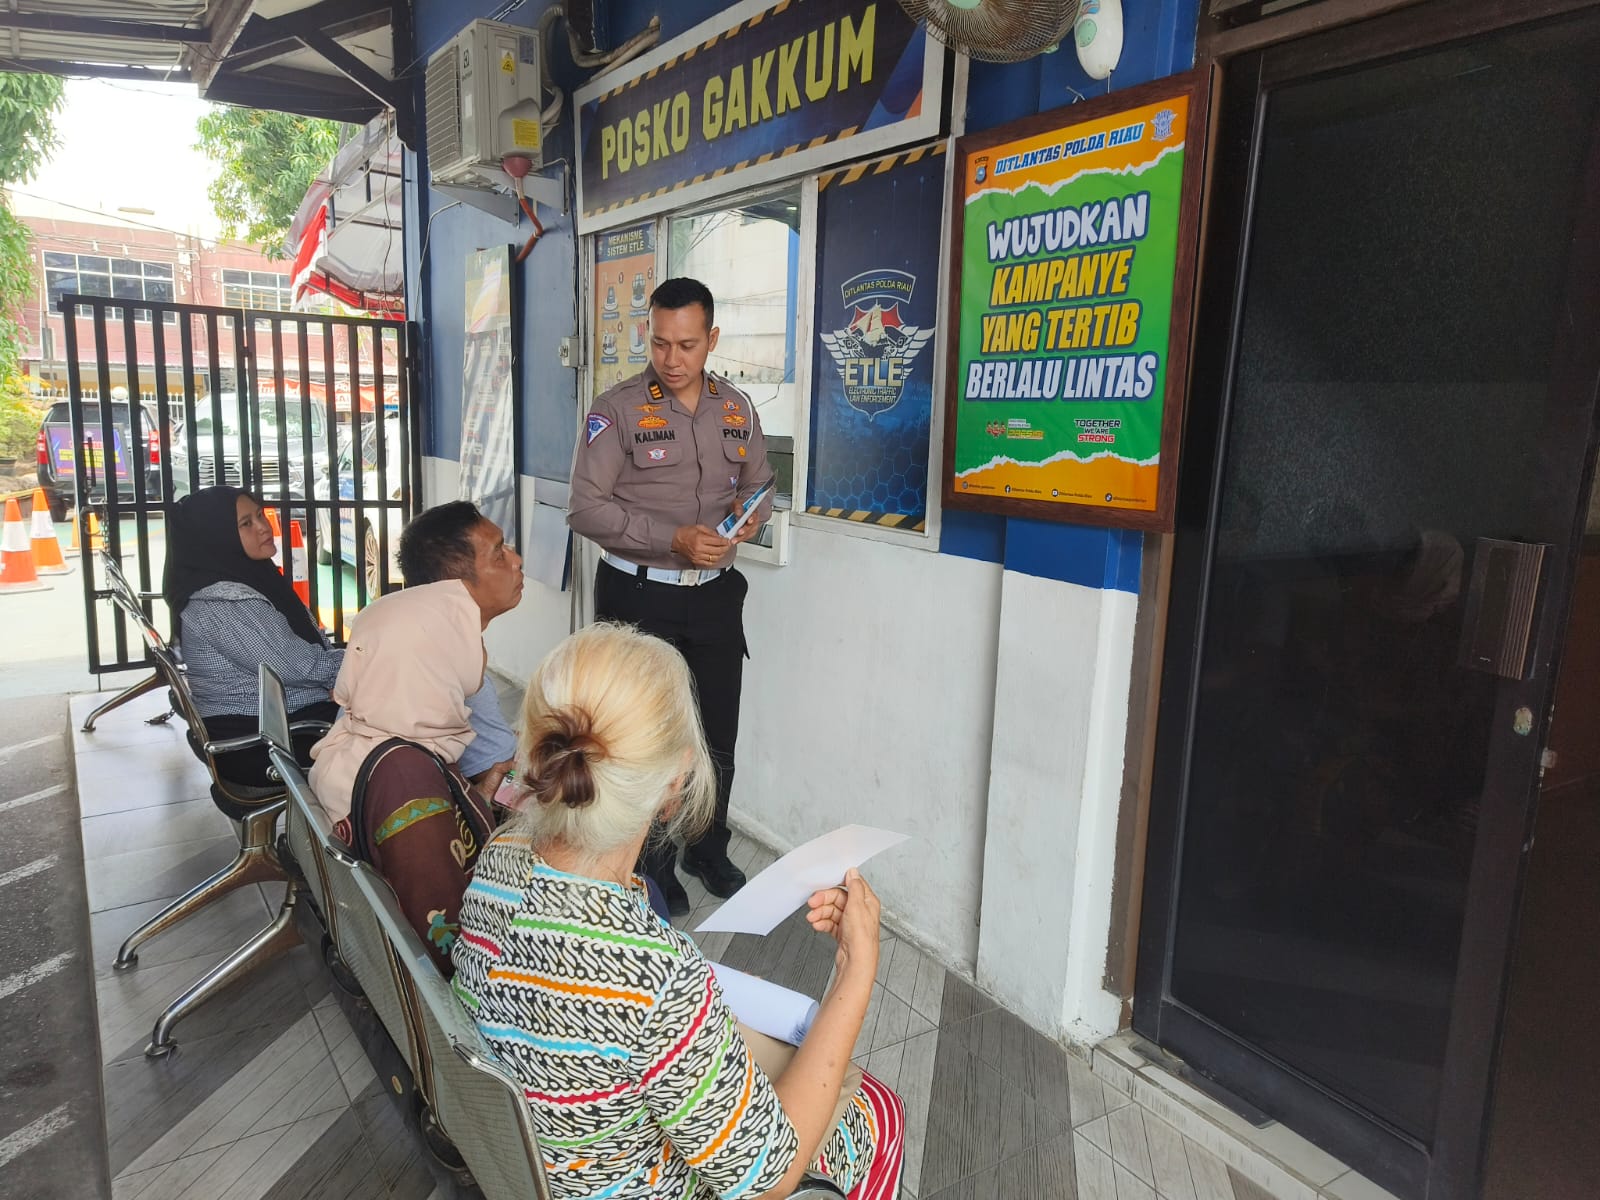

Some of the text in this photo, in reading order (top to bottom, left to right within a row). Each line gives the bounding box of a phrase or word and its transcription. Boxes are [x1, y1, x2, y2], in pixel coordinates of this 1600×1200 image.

[602, 3, 876, 180] POSKO GAKKUM
[995, 123, 1144, 174] DITLANTAS POLDA RIAU
[987, 193, 1148, 261] WUJUDKAN
[630, 241, 644, 253] ETLE
[844, 280, 912, 298] DITLANTAS POLDA RIAU
[990, 248, 1134, 306] KAMPANYE
[981, 302, 1140, 353] YANG TERTIB
[845, 357, 903, 387] ETLE
[965, 354, 1157, 399] BERLALU LINTAS
[634, 430, 676, 444] KALIMAN
[1074, 419, 1121, 428] TOGETHER
[1078, 434, 1115, 442] STRONG
